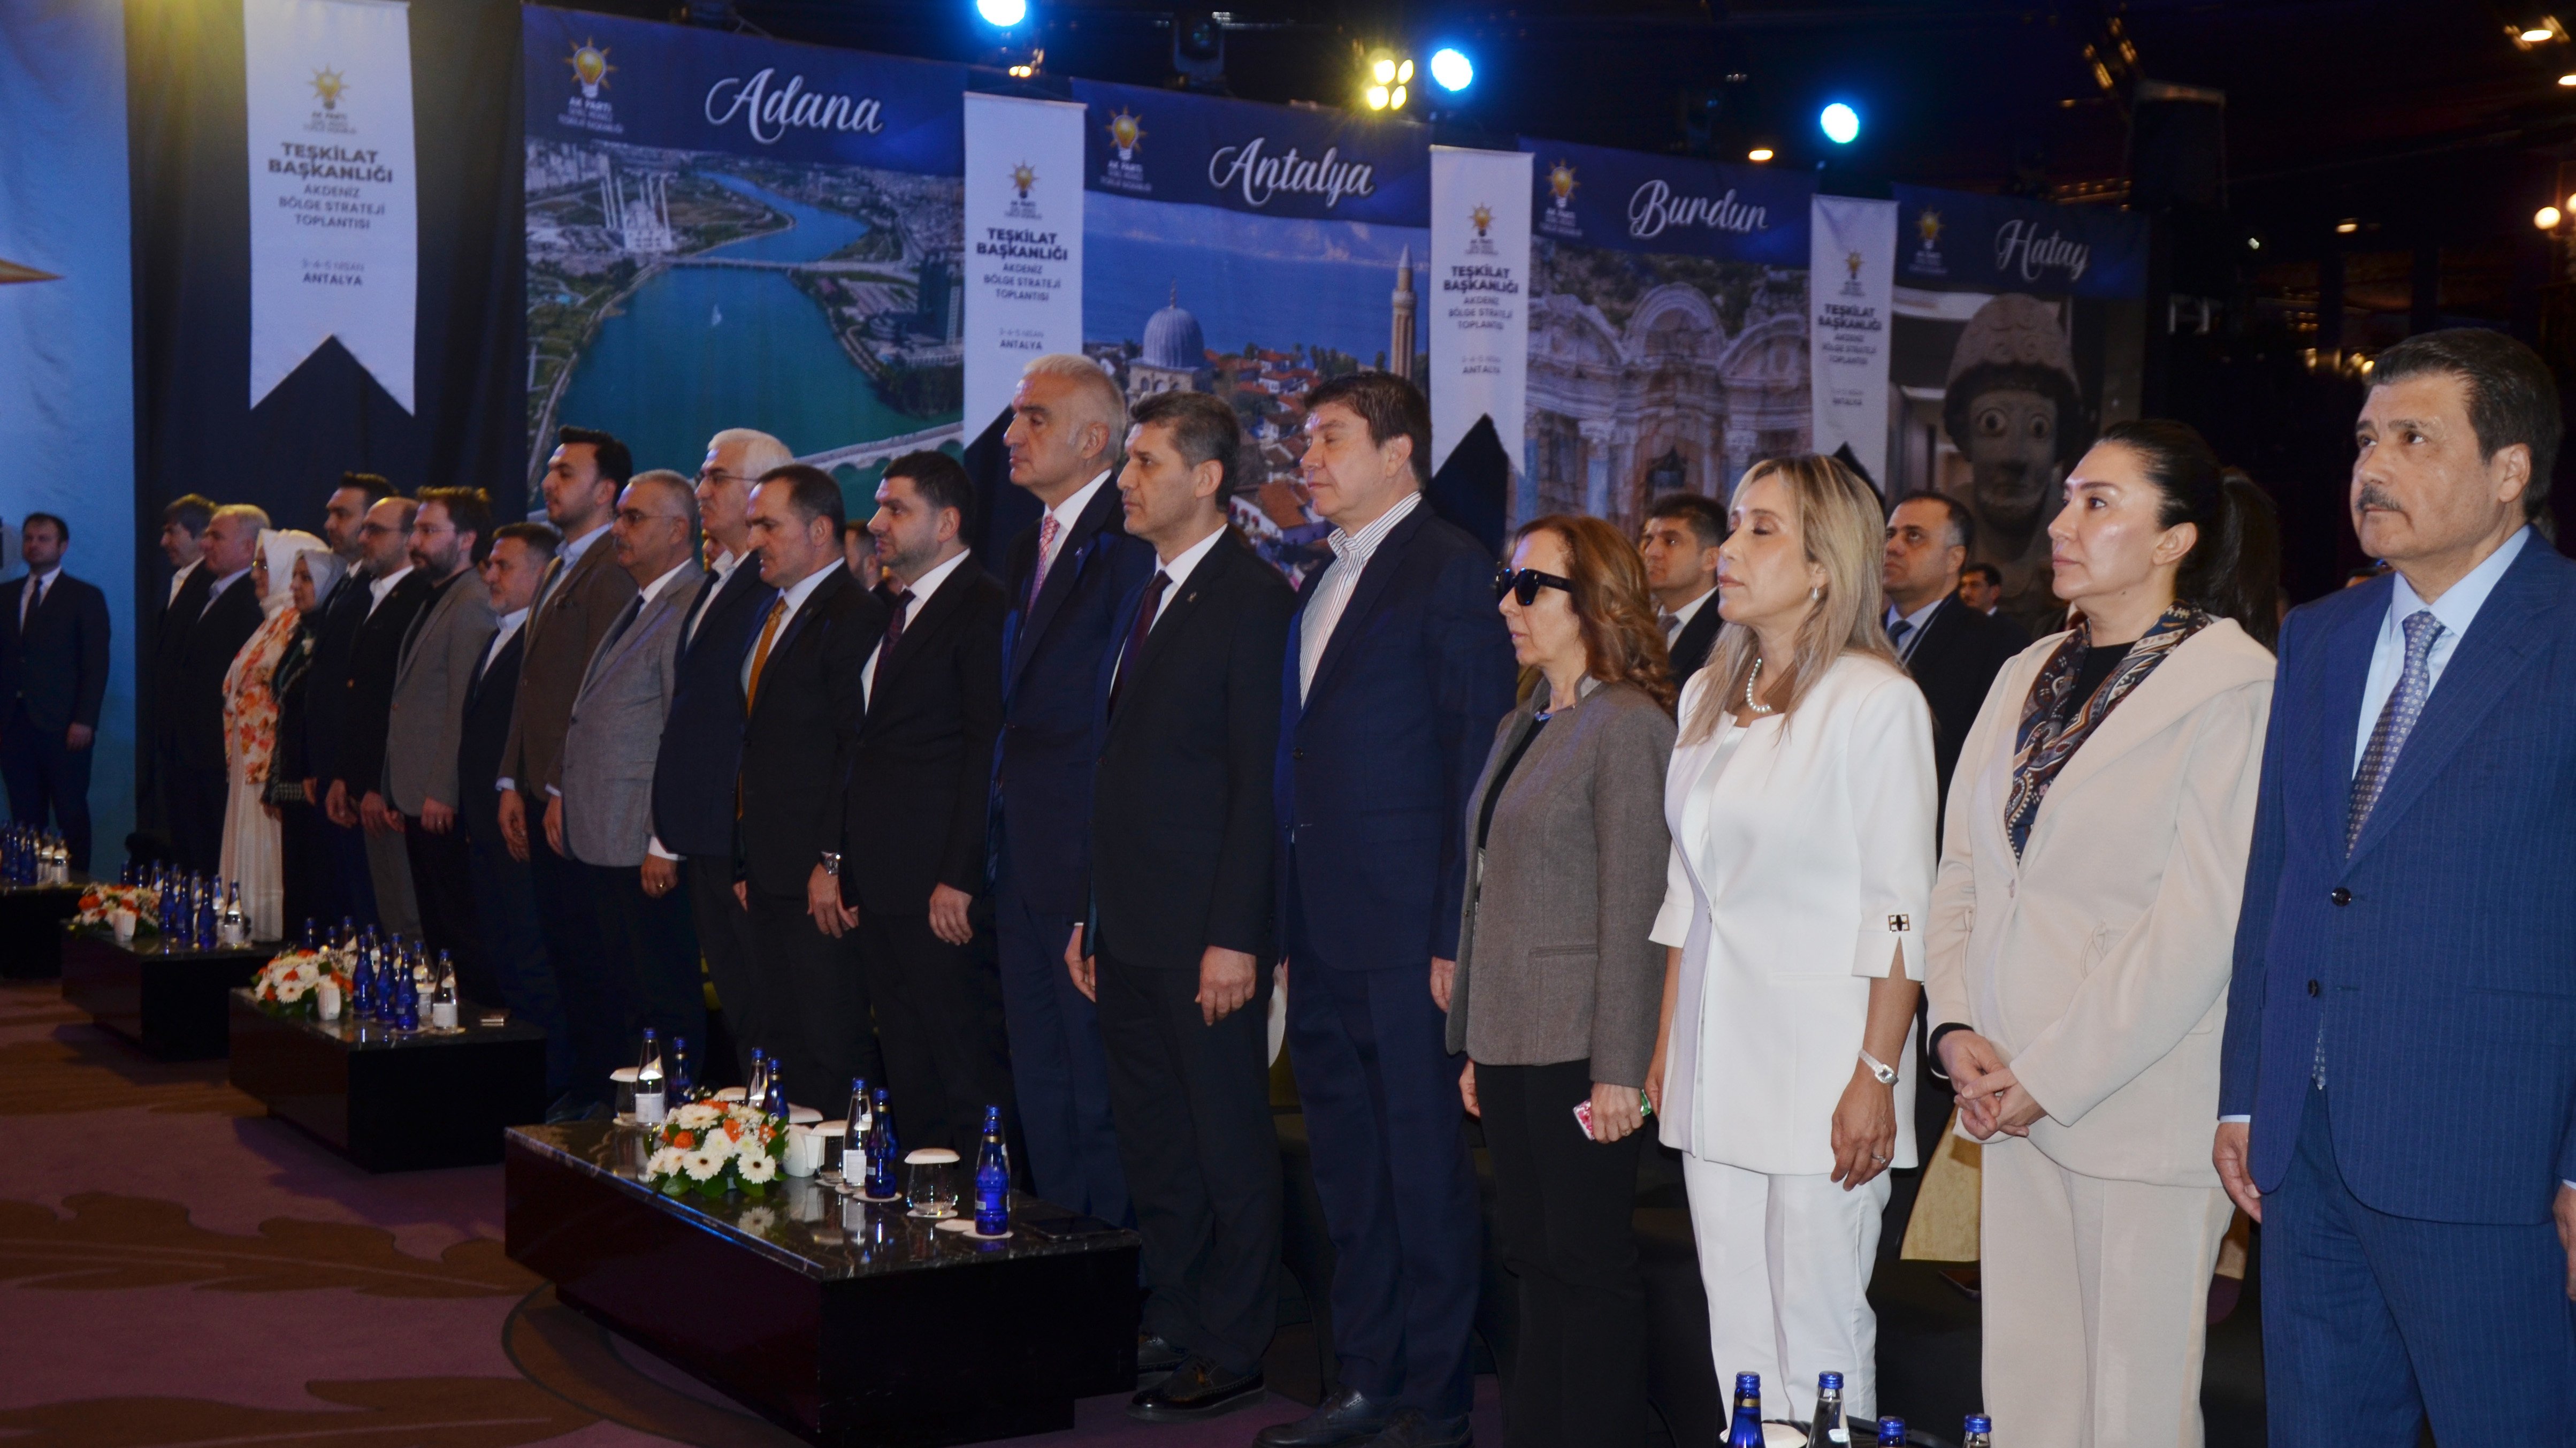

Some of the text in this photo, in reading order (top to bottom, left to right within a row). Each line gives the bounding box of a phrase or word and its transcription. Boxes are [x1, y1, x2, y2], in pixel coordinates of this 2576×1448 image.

[705, 67, 883, 144] Adana
[281, 142, 378, 164] TEŞKİLAT
[269, 158, 393, 183] BAŞKANLIĞI
[1209, 137, 1375, 208] Antalya
[304, 184, 360, 198] AKDENİZ
[279, 195, 385, 215] BÖLGE STRATEJİ
[296, 214, 370, 229] TOPLANTISI
[987, 227, 1058, 245] TEŞKİLAT
[976, 242, 1068, 261] BAŞKANLIĞI
[1996, 219, 2090, 283] Hatay
[1003, 263, 1043, 275] AKDENİZ
[1451, 264, 1510, 279] TEŞKİLAT
[302, 272, 363, 286] ANTALYA
[983, 273, 1061, 288] BÖLGE STRATEJİ
[1444, 279, 1519, 294] BAŞKANLIĞI
[996, 288, 1049, 301] TOPLANTISI
[999, 339, 1042, 350] ANTALYA
